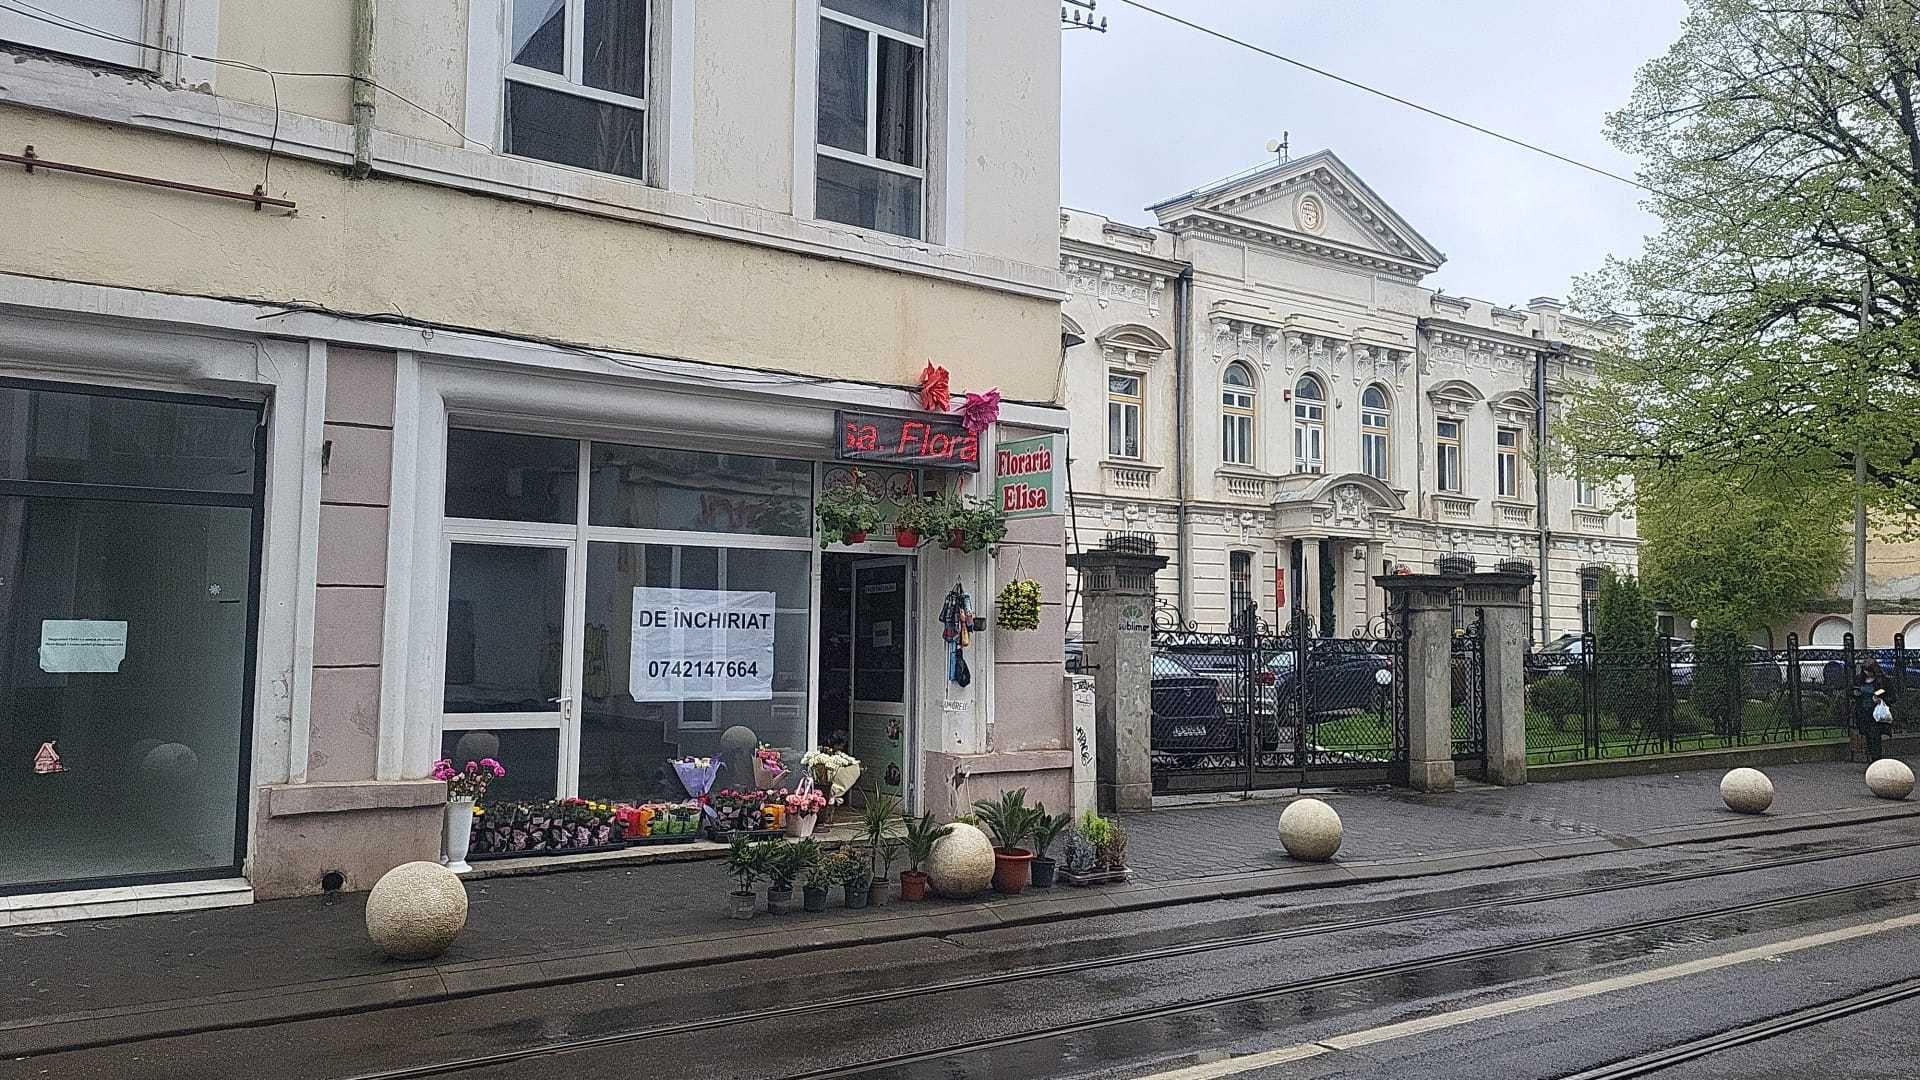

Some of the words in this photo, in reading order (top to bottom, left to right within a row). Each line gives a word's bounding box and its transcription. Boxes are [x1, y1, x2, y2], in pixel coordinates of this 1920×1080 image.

[1002, 483, 1048, 512] Elisa
[640, 610, 667, 628] DE
[673, 606, 770, 630] ÎNCHIRIAT
[648, 660, 758, 678] 0742147664
